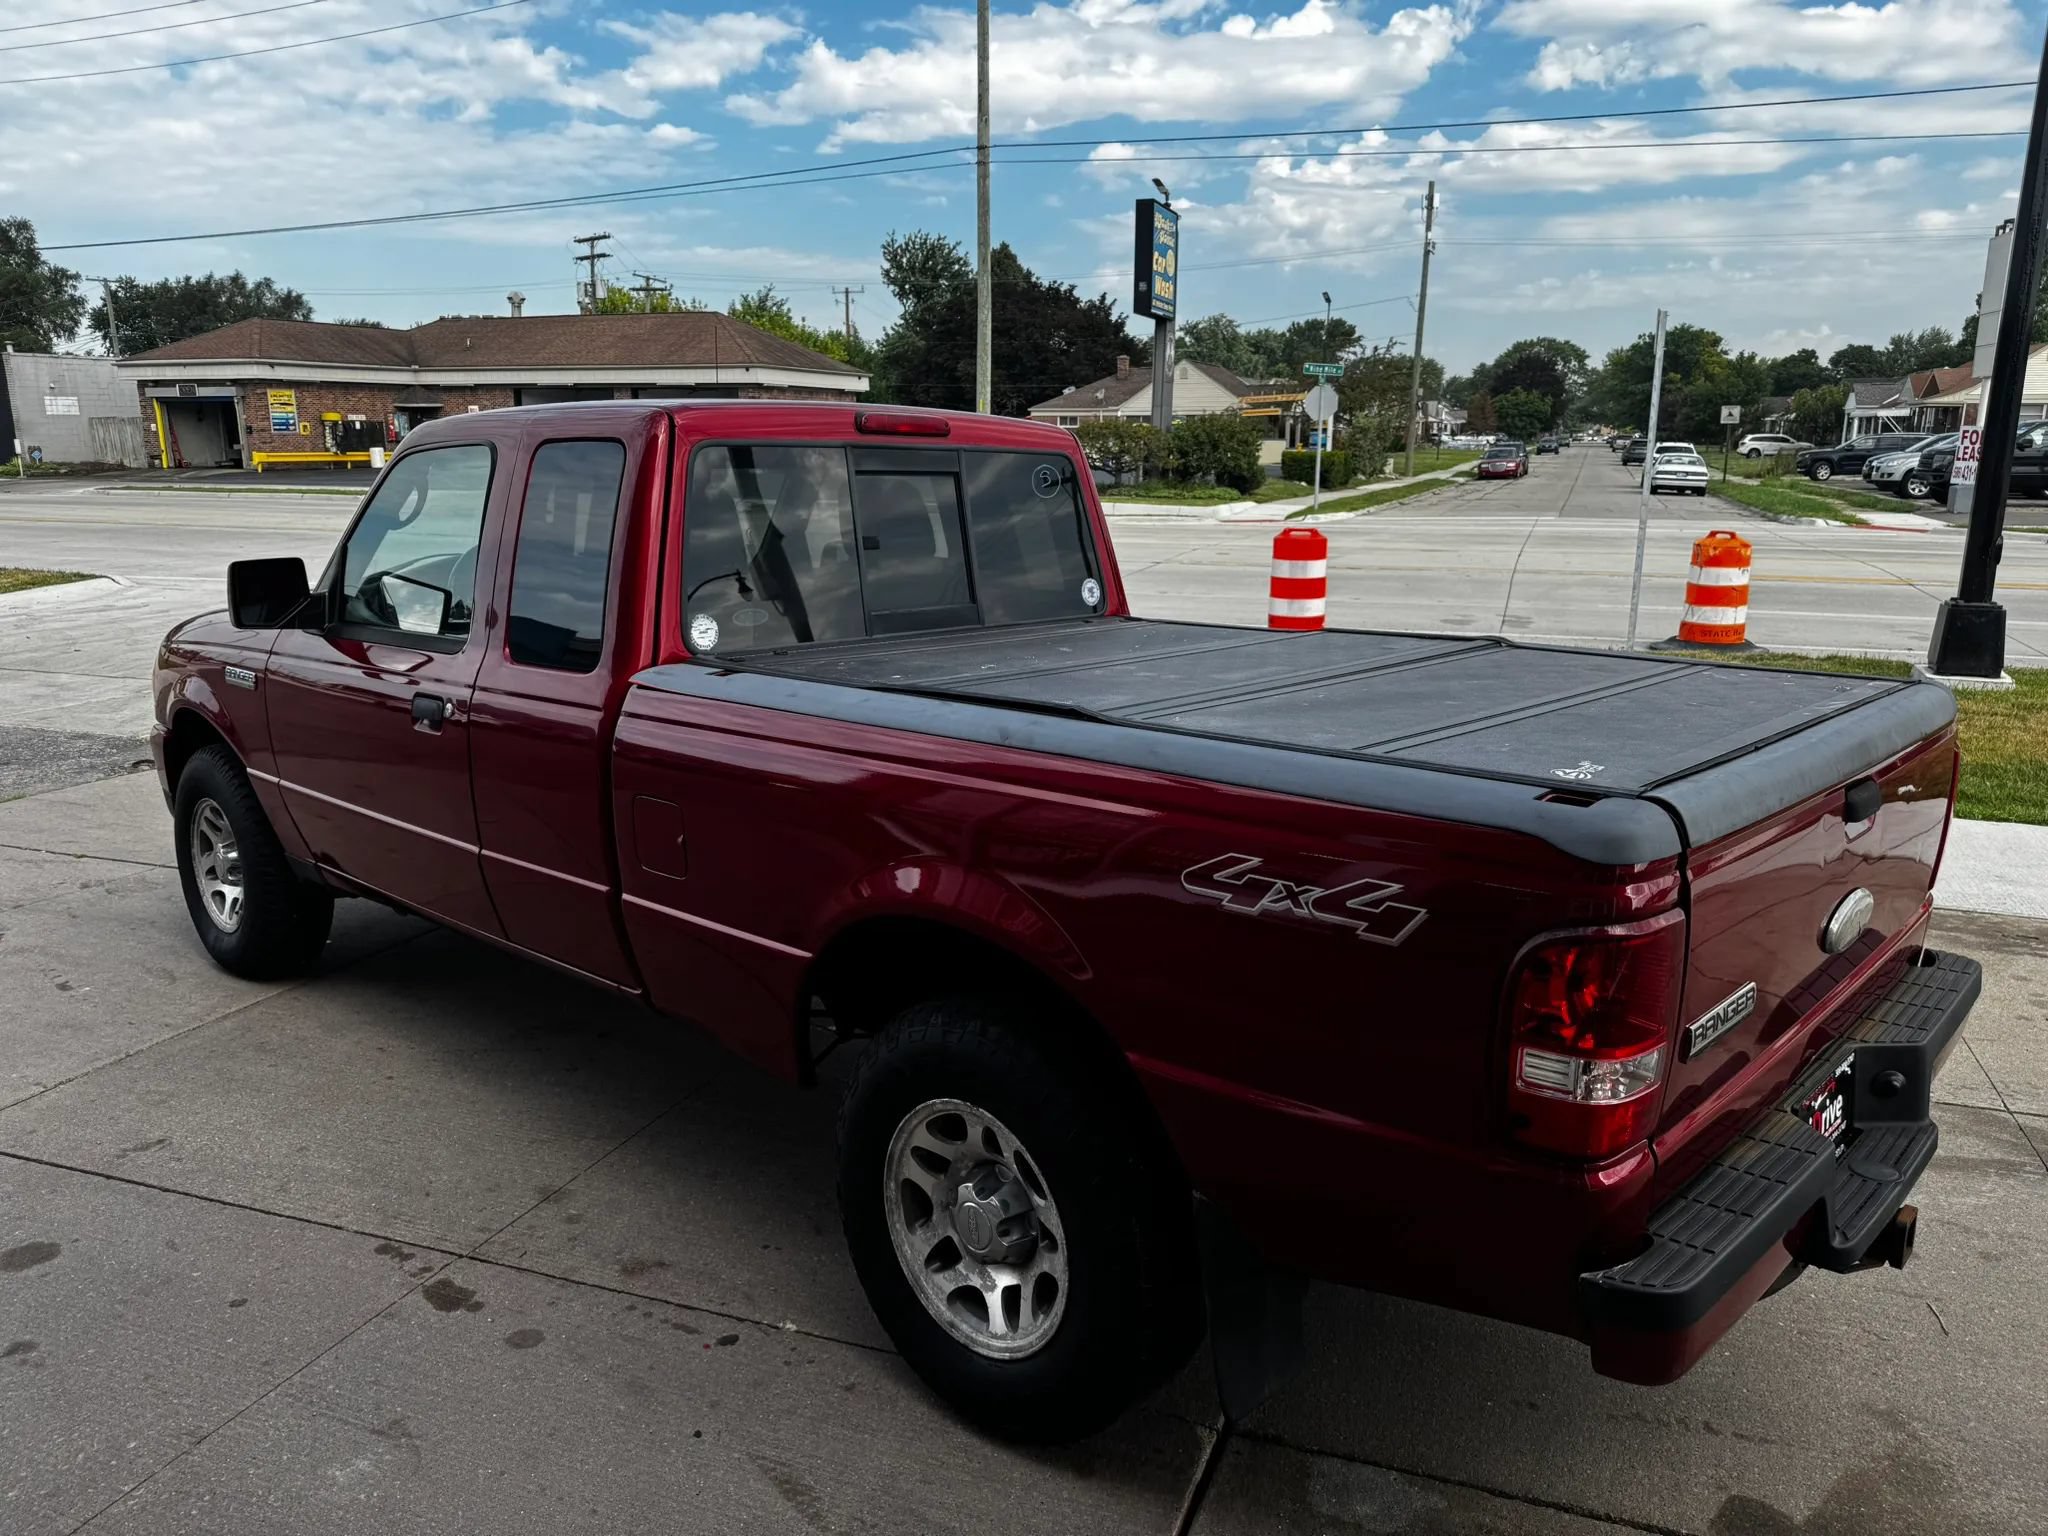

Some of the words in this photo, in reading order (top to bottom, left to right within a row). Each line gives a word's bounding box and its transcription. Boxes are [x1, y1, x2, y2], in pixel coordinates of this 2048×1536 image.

[1961, 429, 1983, 446] FO
[1181, 853, 1430, 947] 4x4
[1693, 986, 1756, 1050] RANGER
